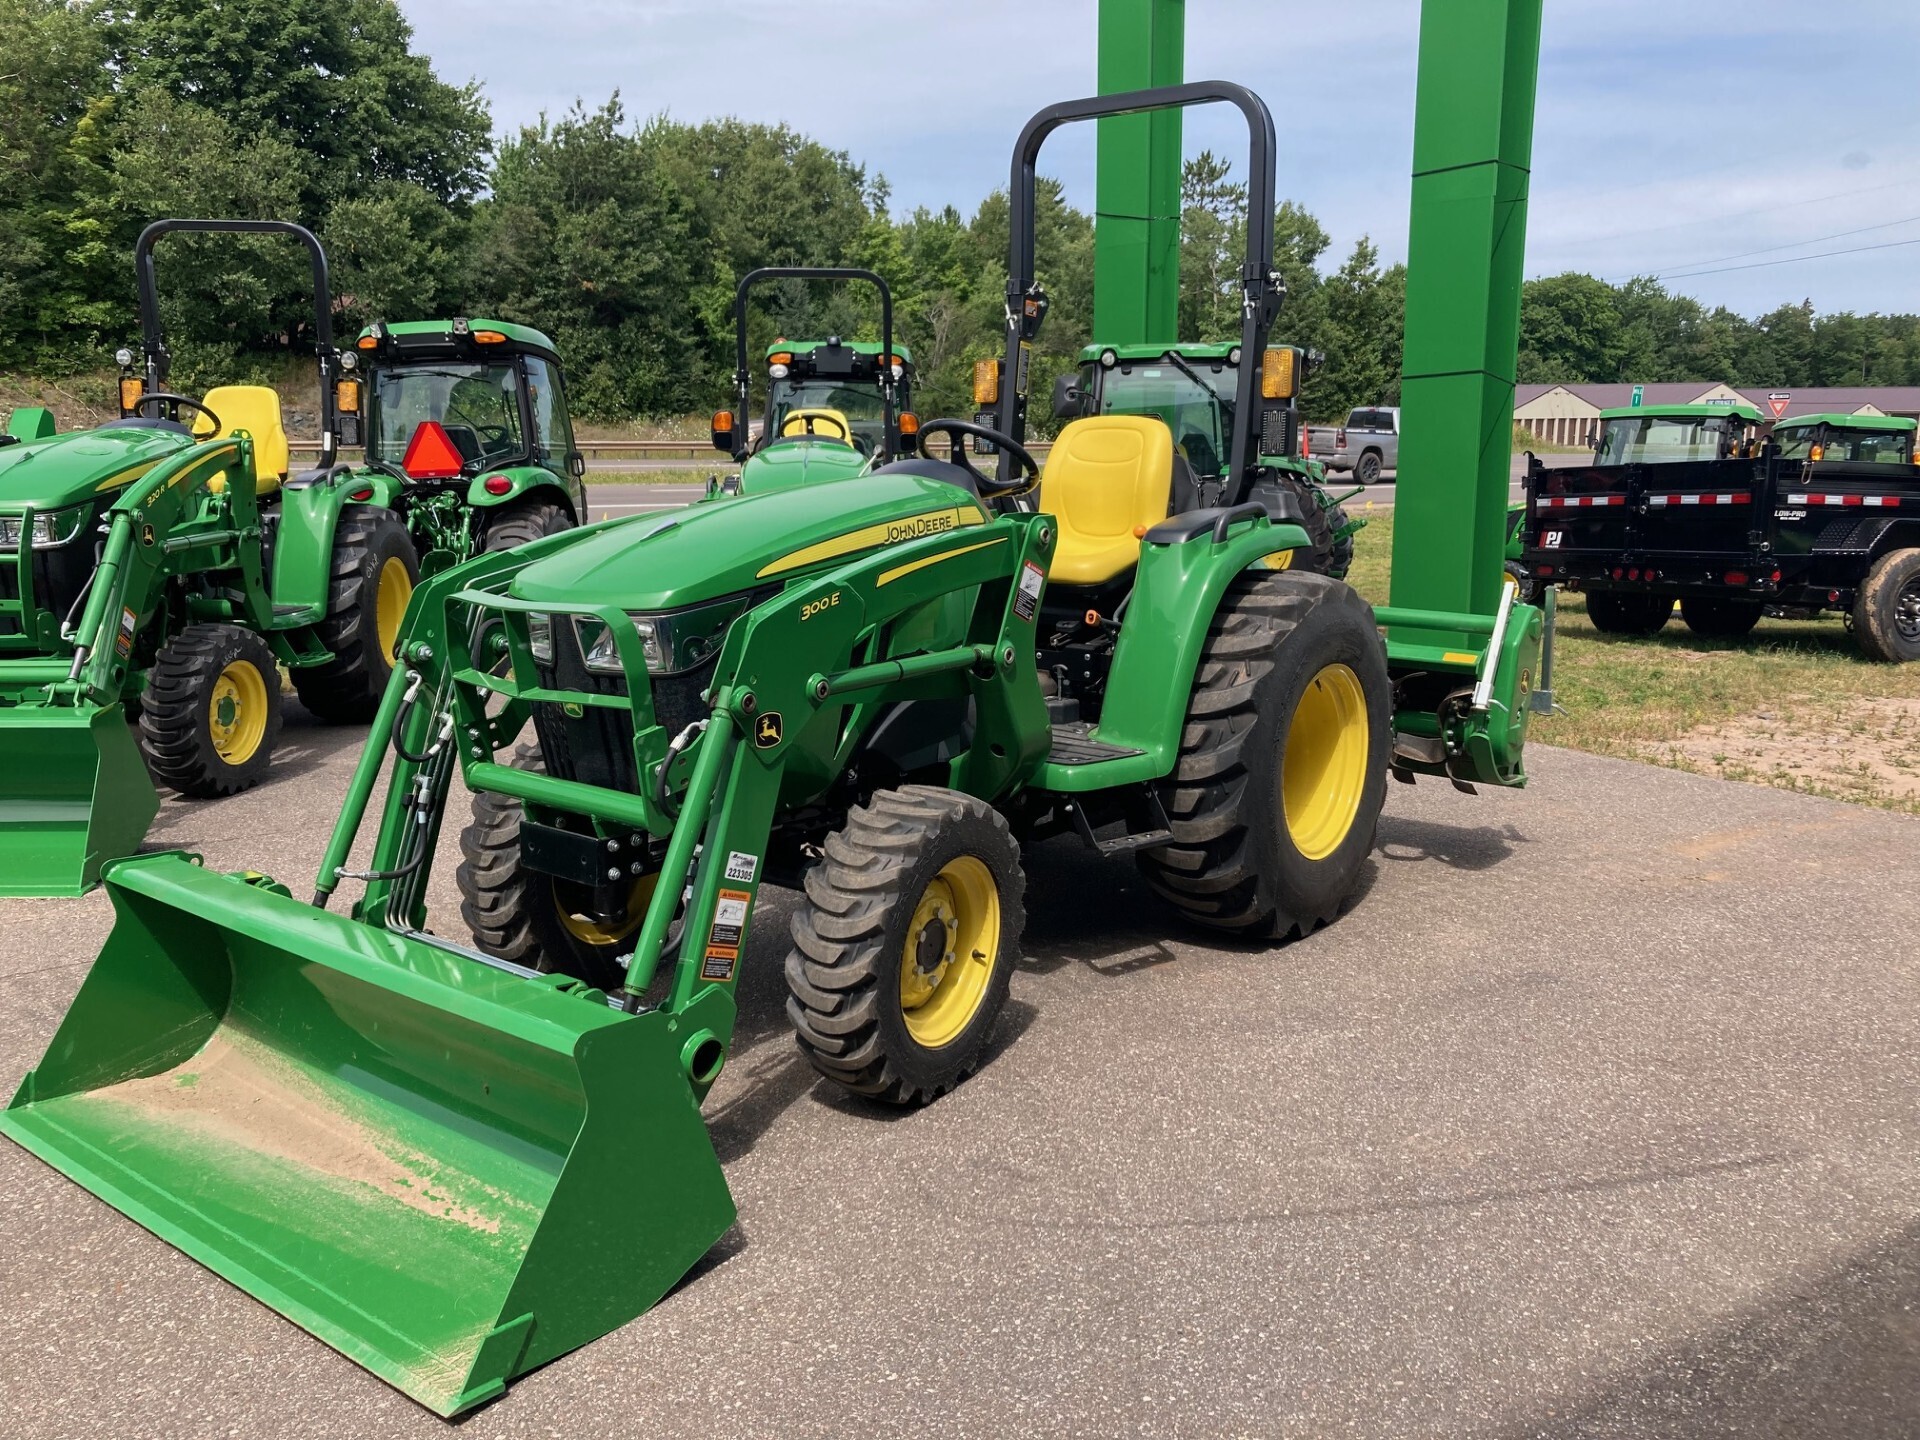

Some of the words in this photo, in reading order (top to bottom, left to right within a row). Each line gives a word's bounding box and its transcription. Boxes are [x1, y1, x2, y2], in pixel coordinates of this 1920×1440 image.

[160, 484, 165, 494] R
[884, 523, 916, 543] JOHN
[916, 516, 952, 535] DEERE
[1545, 531, 1563, 545] PJ
[801, 602, 831, 621] 300
[830, 591, 841, 606] E
[727, 867, 753, 881] 223305
[727, 892, 747, 900] WARNING
